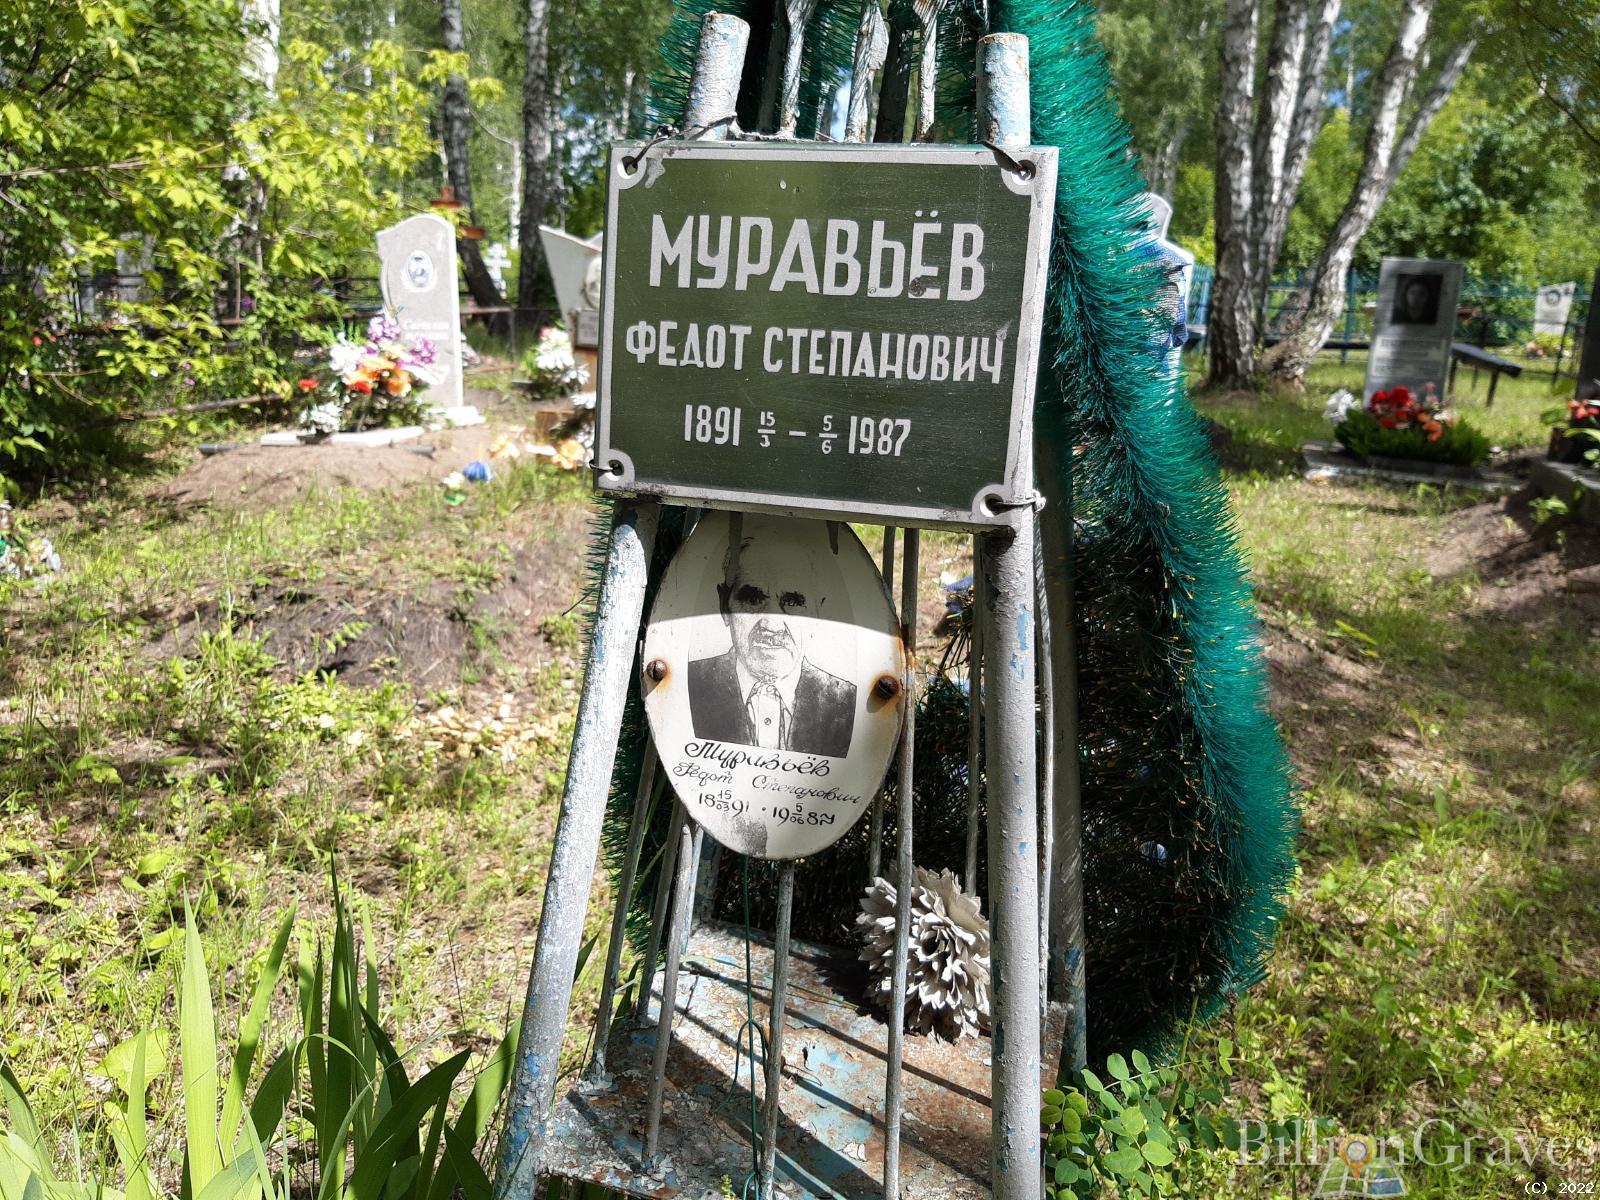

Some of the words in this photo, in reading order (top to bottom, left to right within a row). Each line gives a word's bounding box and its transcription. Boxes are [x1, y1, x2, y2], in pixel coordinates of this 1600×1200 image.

[649, 209, 987, 302] МУРАВЬЁВ
[625, 320, 753, 371] ФЕДОТ
[762, 326, 1006, 384] СТЕПАНОВИЧ
[684, 404, 742, 447] 1891
[848, 415, 912, 457] 1987
[673, 762, 733, 786] Федот
